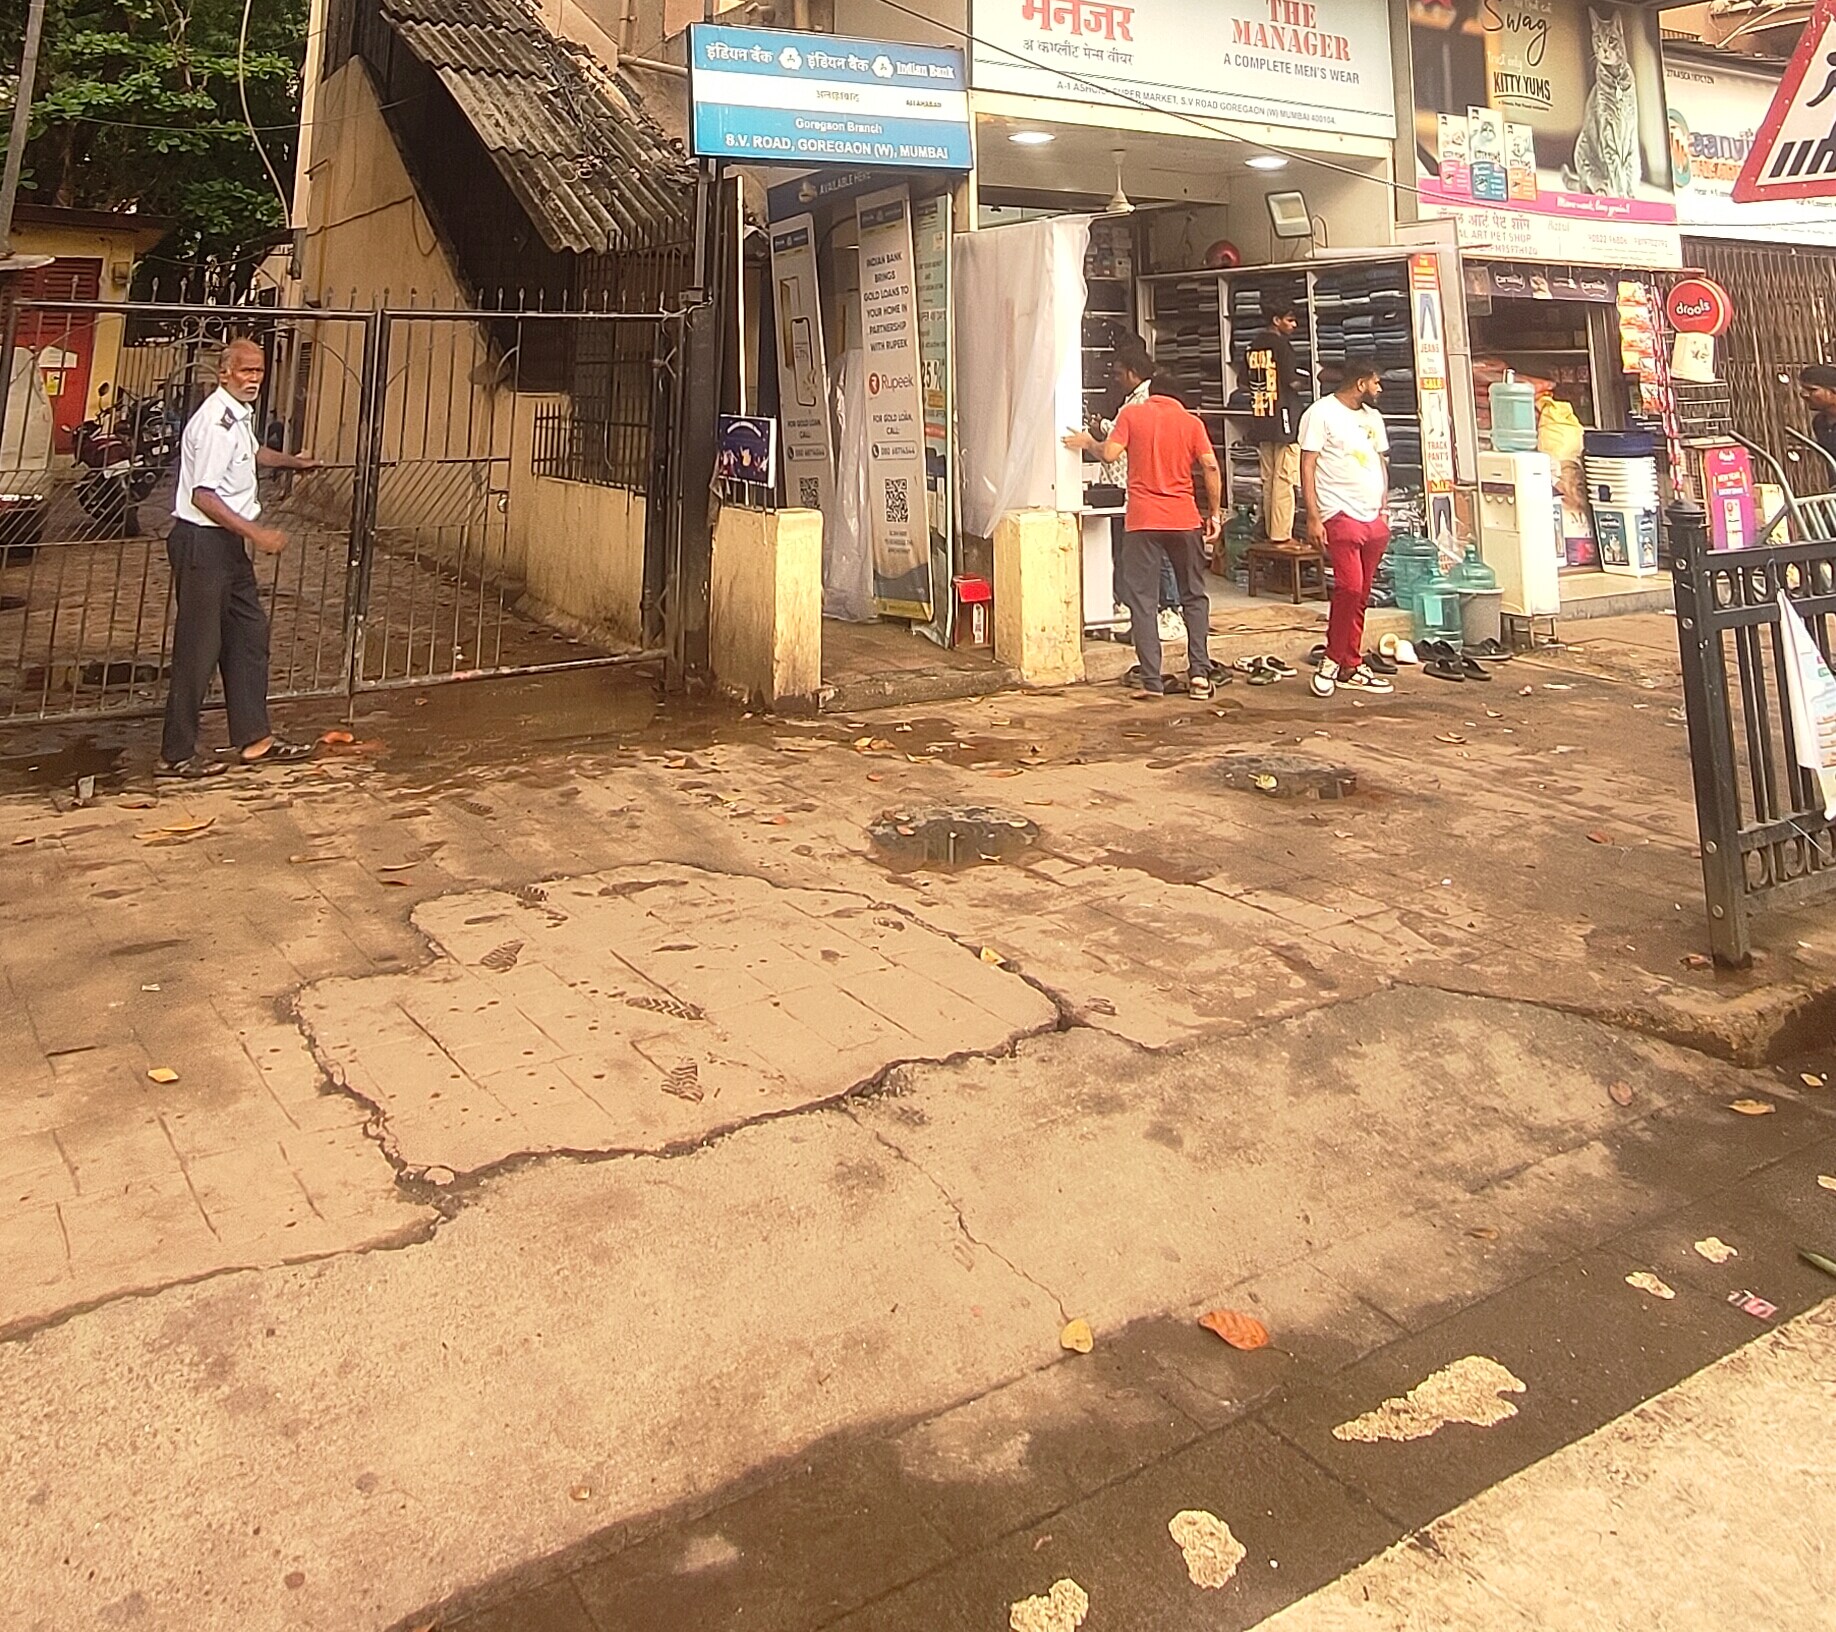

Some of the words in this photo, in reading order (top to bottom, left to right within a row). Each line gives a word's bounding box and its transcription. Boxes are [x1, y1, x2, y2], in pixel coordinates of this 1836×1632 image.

[1230, 17, 1351, 62] MANAGER
[705, 41, 748, 62] इंडियन
[806, 50, 847, 71] इंडियन
[895, 61, 929, 77] Indian
[929, 64, 956, 79] Bank
[1223, 52, 1232, 66] A
[1234, 53, 1293, 75] COMPLETE
[1294, 63, 1327, 80] MEN'S
[1329, 68, 1361, 85] WEAR
[1493, 70, 1521, 94] KITTY
[1523, 74, 1551, 101] YUMS
[1195, 98, 1218, 109] ROAD
[1219, 101, 1265, 116] GOREGAON
[1266, 107, 1279, 119] (W)
[1279, 108, 1311, 122] MUMBAI
[795, 117, 846, 132] Goregaon
[847, 121, 883, 135] Branch
[752, 134, 796, 152] ROAD,
[797, 138, 872, 155] GOREGAON
[874, 143, 898, 159] (W),
[899, 144, 949, 160] MUMBAI
[1511, 213, 1530, 231] शॉप
[1471, 230, 1488, 240] ART
[1508, 232, 1532, 243] SHOP
[886, 251, 903, 264] BANK
[874, 270, 897, 284] BRINGS
[863, 290, 880, 302] GOLD
[881, 286, 900, 299] LOANS
[900, 285, 910, 295] TO
[866, 307, 883, 319] YOUR
[883, 303, 901, 316] HOME
[1675, 297, 1711, 316] drools
[869, 320, 907, 335] PARTNERSHIP
[870, 341, 886, 352] WITH
[886, 338, 909, 350] RUPEEK
[1420, 343, 1440, 353] JEANS
[881, 373, 915, 392] Rupeek
[1423, 377, 1444, 390] SALE
[872, 414, 883, 423] FOR
[884, 413, 897, 423] GOLD
[1427, 440, 1448, 450] TRACK
